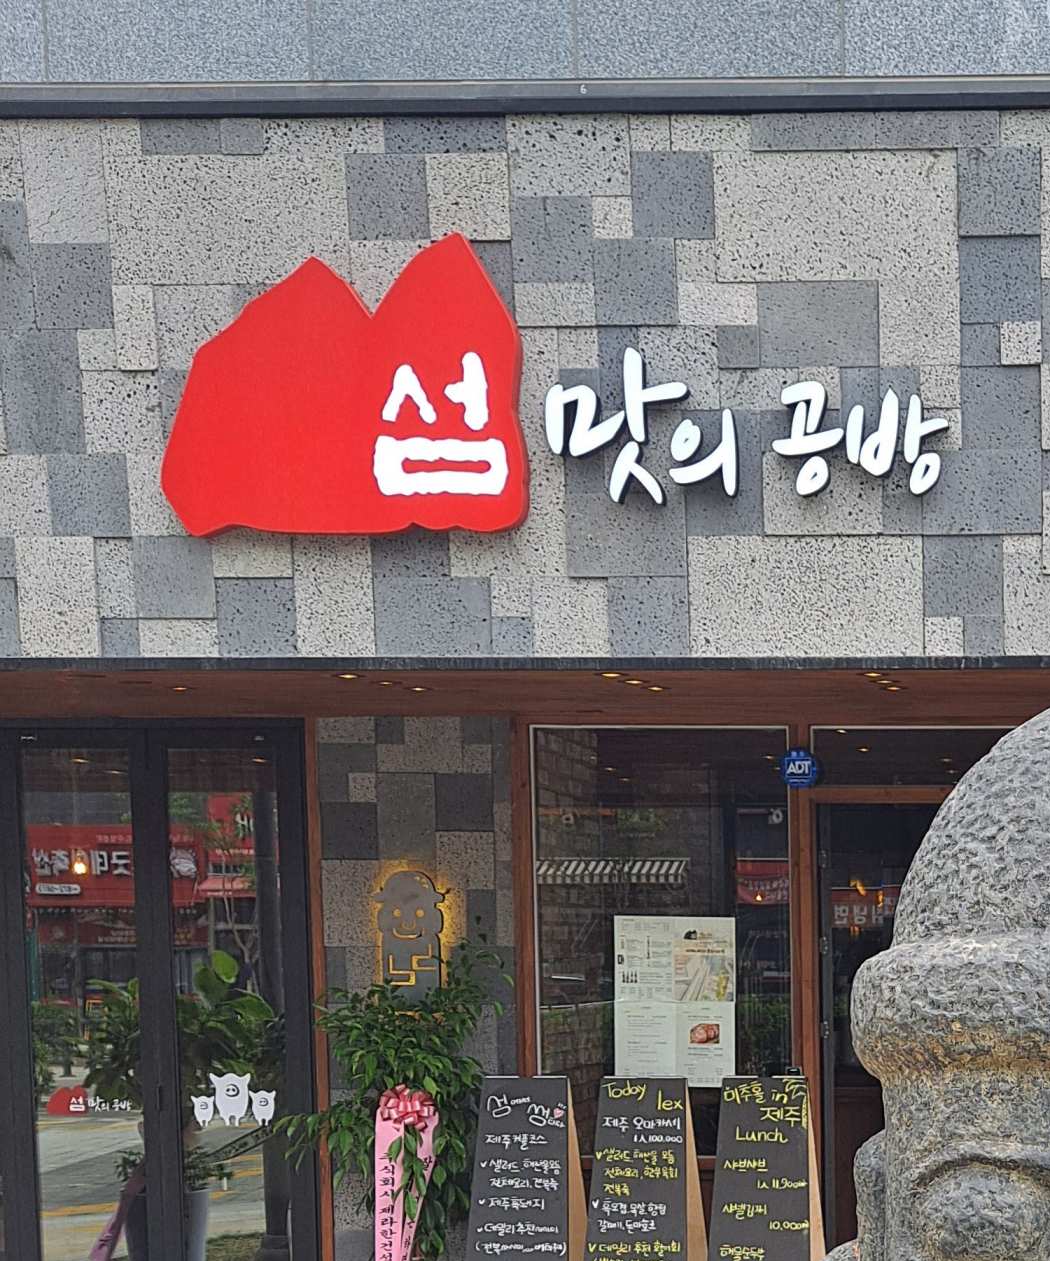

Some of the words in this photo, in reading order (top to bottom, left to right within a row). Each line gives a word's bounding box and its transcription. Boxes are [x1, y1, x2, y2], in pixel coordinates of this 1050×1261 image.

[372, 350, 508, 496] 섬
[545, 345, 740, 506] 맛의
[771, 379, 951, 499] 공방
[786, 760, 811, 774] ADT
[601, 1080, 647, 1100] Today
[723, 1081, 766, 1104] 미추홀
[771, 1089, 788, 1104] in
[602, 1116, 629, 1132] 제주
[633, 1116, 681, 1130] 오마카세
[760, 1106, 801, 1127] 제주
[735, 1126, 789, 1143] Lunch
[723, 1159, 768, 1172] 샤브샤브
